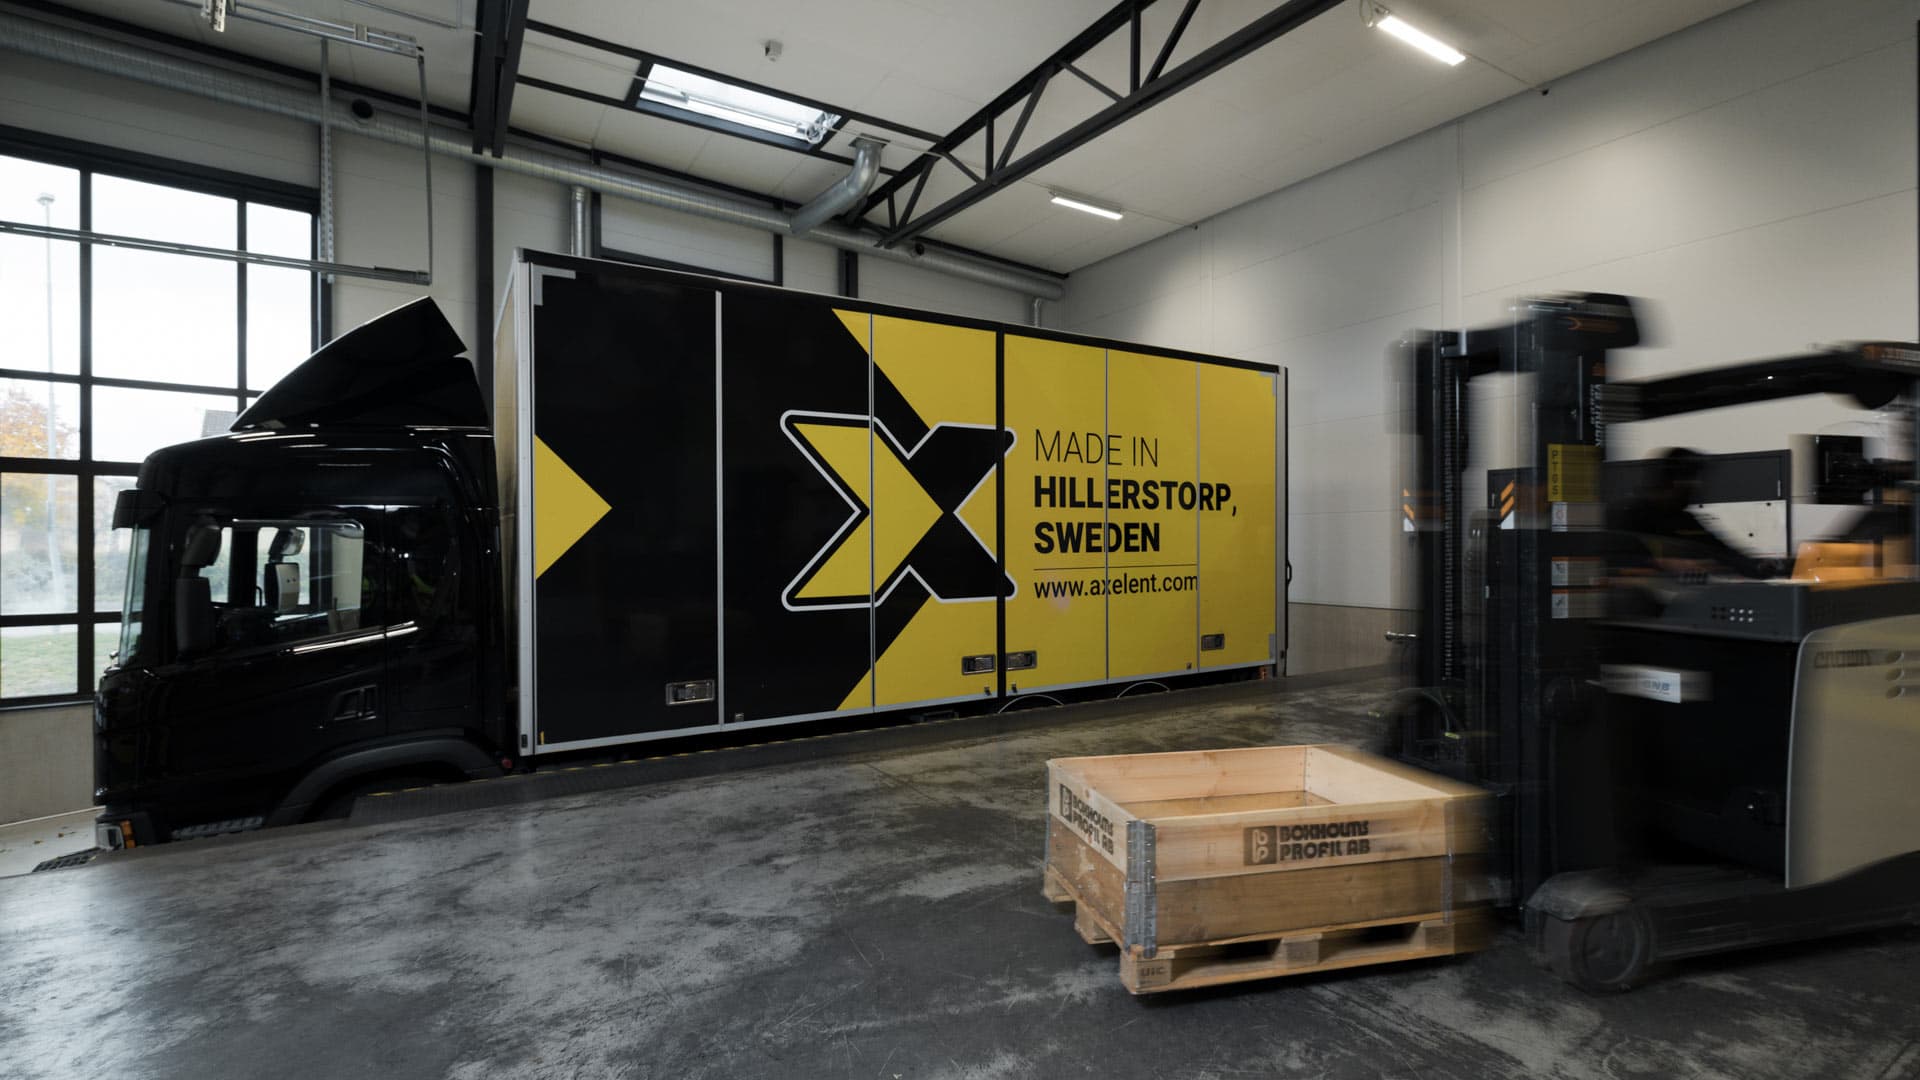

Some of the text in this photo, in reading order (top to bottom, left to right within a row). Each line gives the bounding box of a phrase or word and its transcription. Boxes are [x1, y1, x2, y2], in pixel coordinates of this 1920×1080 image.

[1035, 428, 1159, 468] MADE IN
[1034, 475, 1238, 517] HILLERSTORP,
[1034, 521, 1160, 554] SWEDEN
[1034, 573, 1199, 599] www.axelent.com
[1102, 833, 1114, 856] AB
[1279, 839, 1371, 861] PROFIL AB
